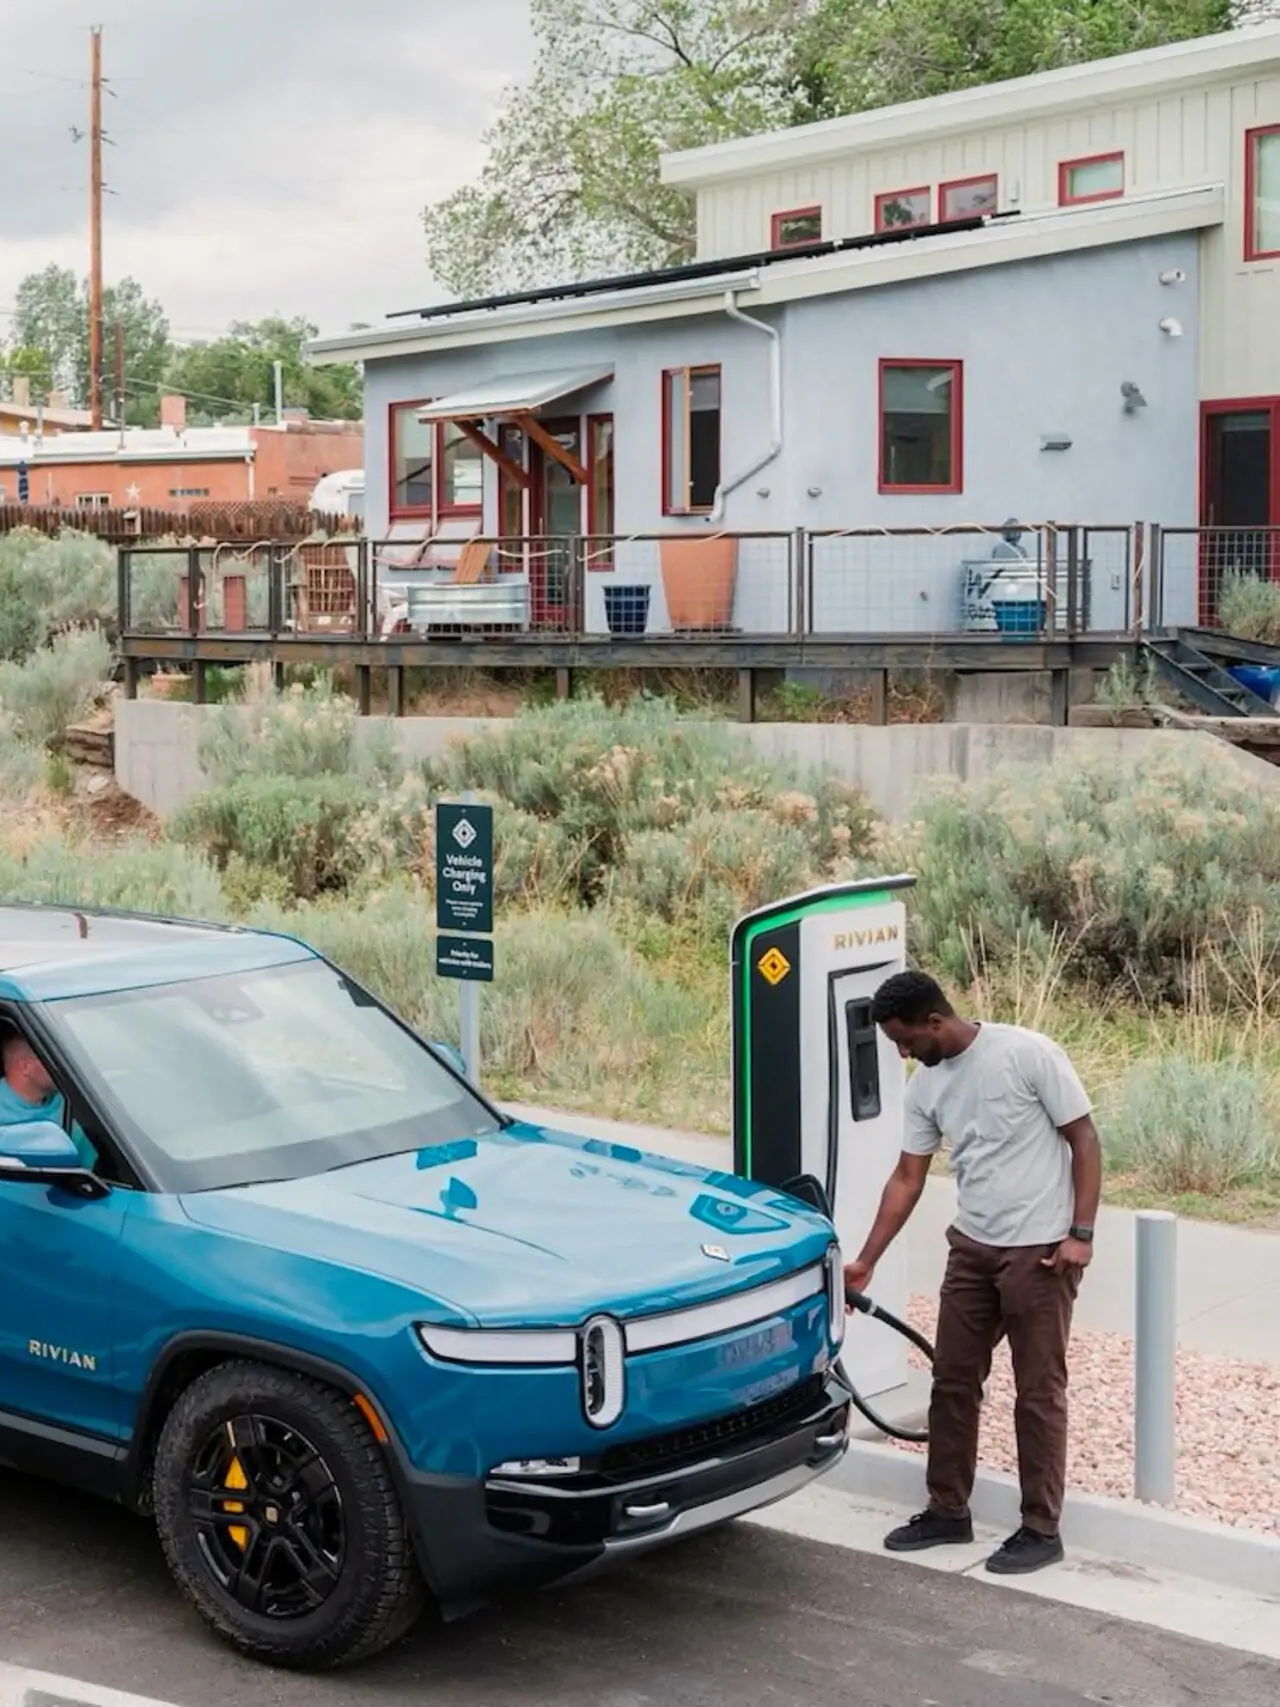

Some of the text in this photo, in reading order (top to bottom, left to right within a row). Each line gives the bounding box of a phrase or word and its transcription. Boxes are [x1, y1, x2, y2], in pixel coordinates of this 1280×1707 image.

[445, 854, 483, 867] Vehicle
[442, 867, 487, 884] Charging
[452, 881, 476, 896] Only
[833, 924, 899, 951] RIVIAN
[28, 1339, 96, 1371] RIVIAN
